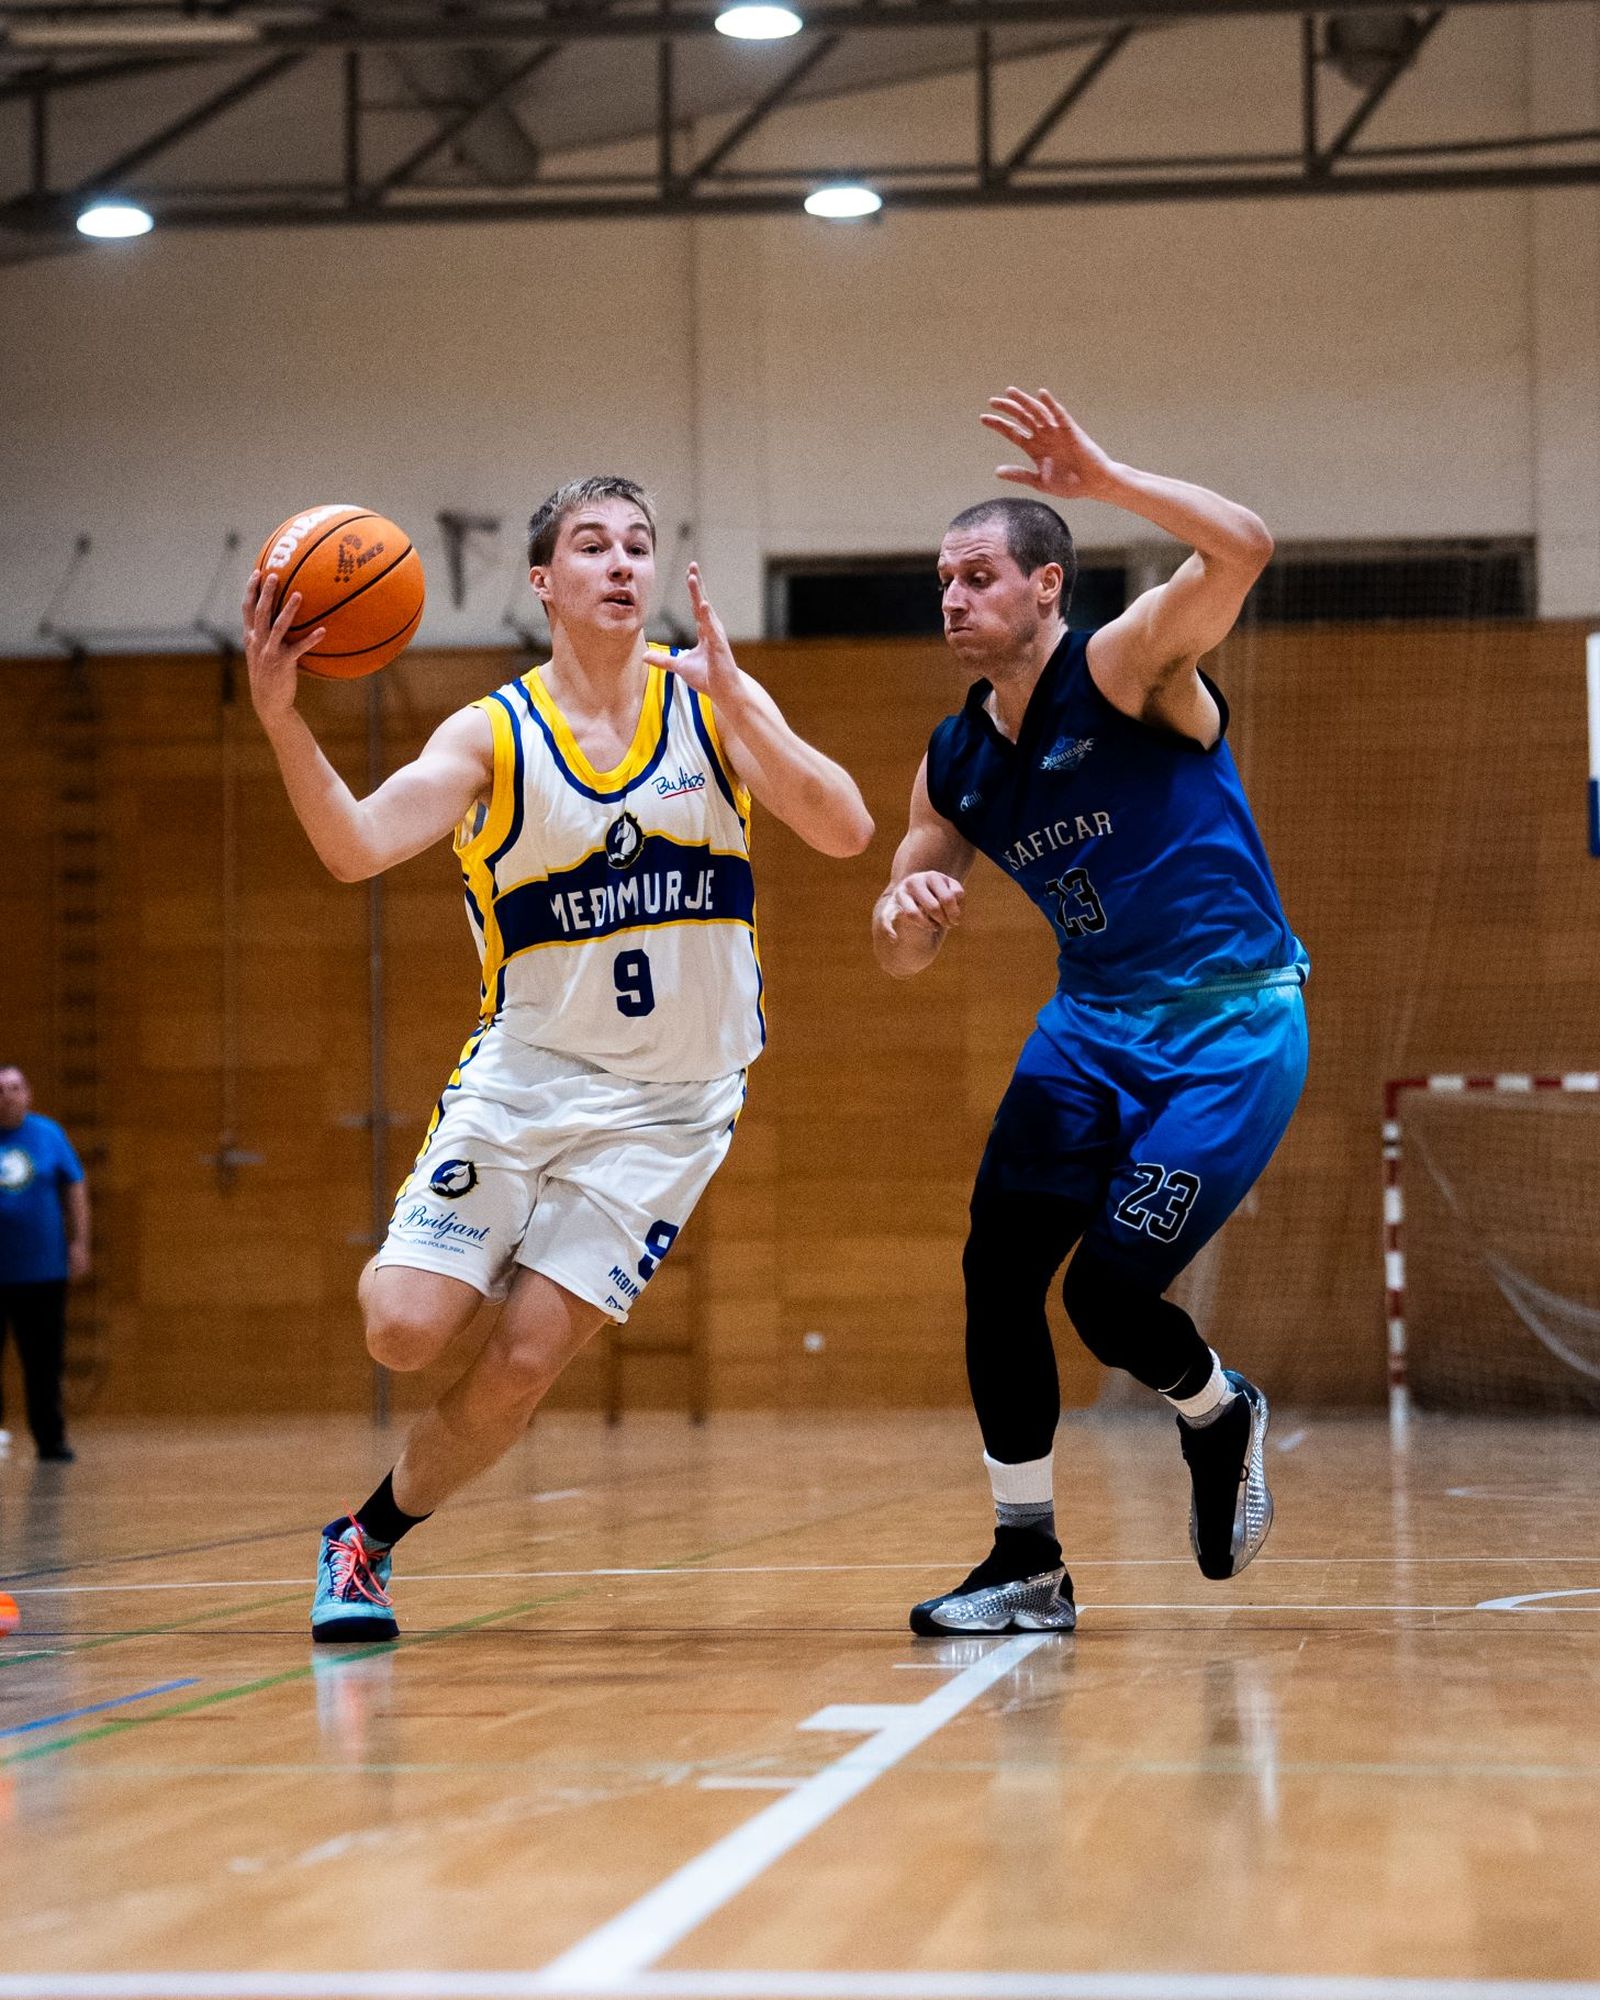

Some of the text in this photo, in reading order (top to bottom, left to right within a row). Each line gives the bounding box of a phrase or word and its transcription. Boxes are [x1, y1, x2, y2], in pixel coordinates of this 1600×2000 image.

[550, 869, 715, 932] MEĐIMURJE
[1045, 867, 1107, 940] 23
[613, 948, 656, 1018] 9
[399, 1205, 491, 1241] Briljant
[1114, 1163, 1201, 1243] 23
[637, 1219, 680, 1283] 9
